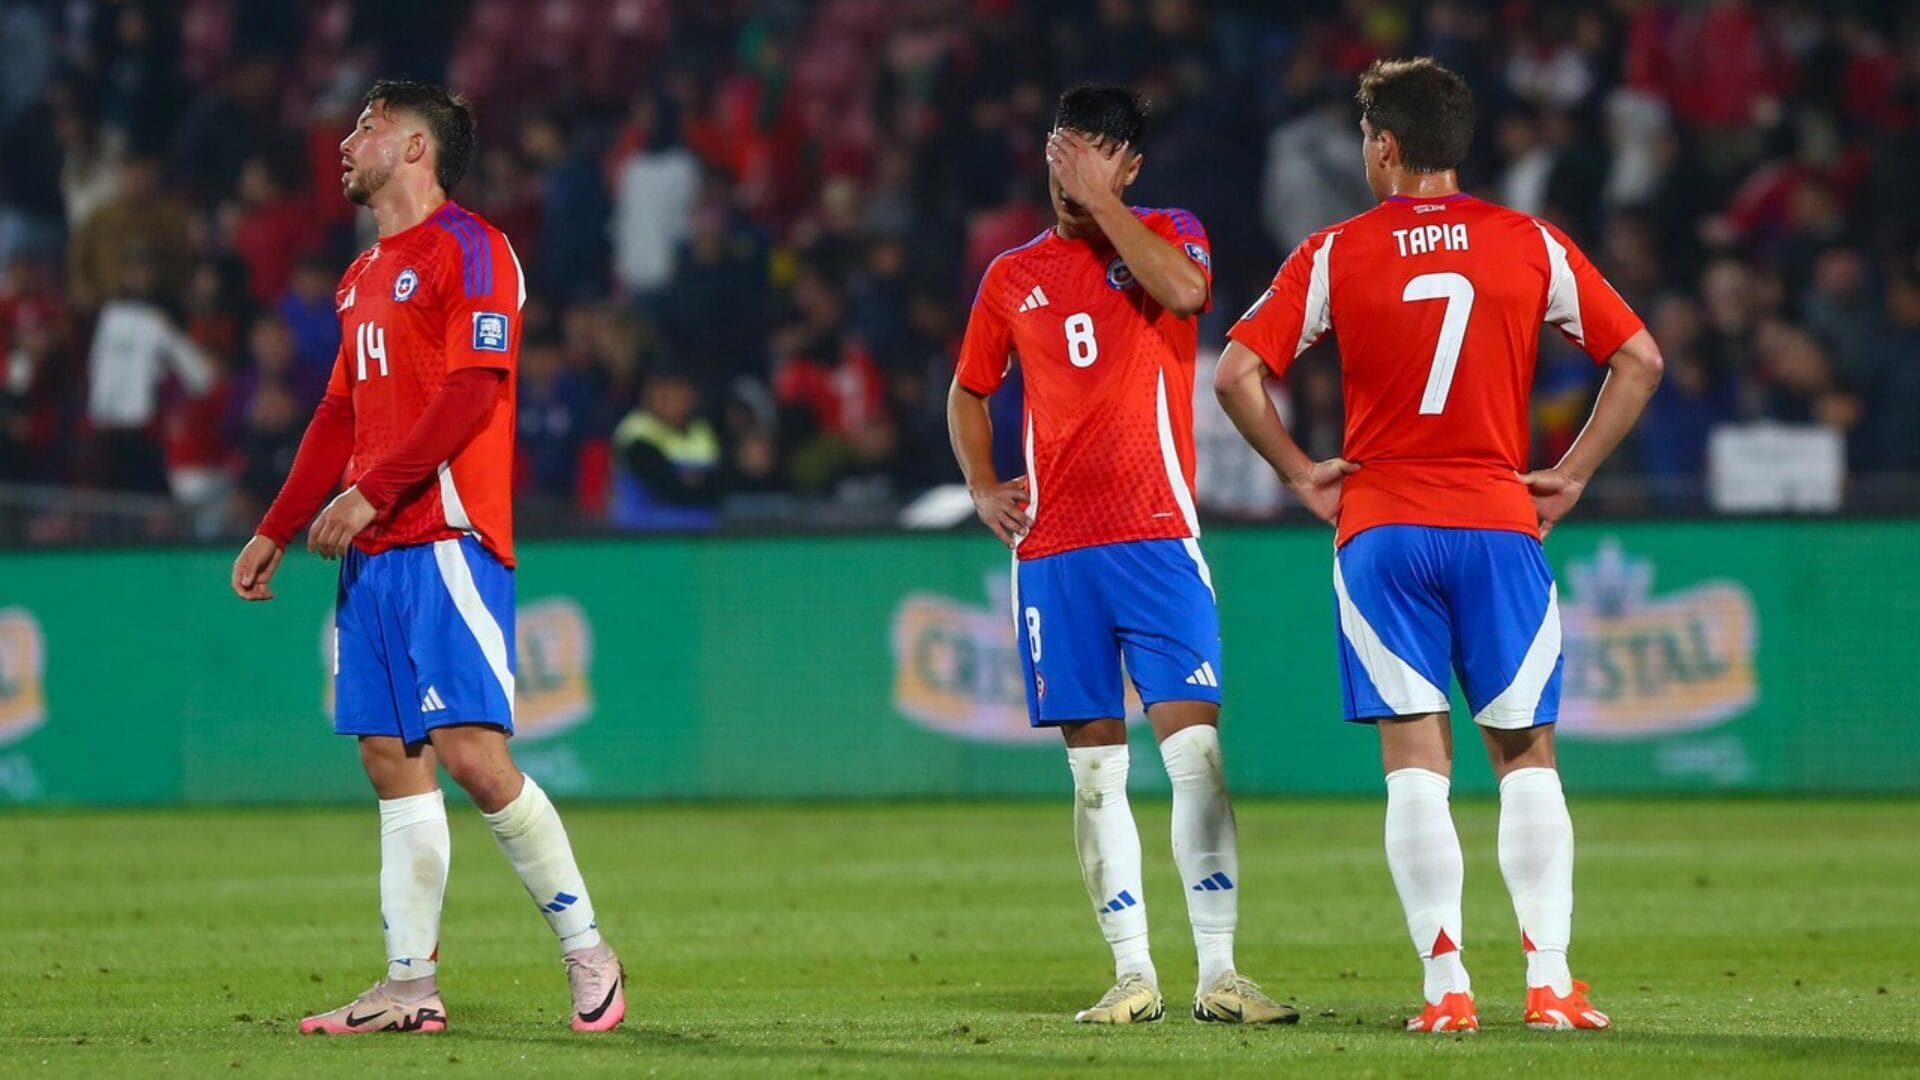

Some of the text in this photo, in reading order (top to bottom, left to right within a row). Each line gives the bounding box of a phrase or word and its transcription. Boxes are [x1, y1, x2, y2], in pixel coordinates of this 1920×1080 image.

[1392, 223, 1469, 257] TAPIA
[356, 321, 388, 380] 14
[1065, 312, 1098, 367] 8
[1402, 272, 1475, 415] 7
[1025, 606, 1041, 663] 8
